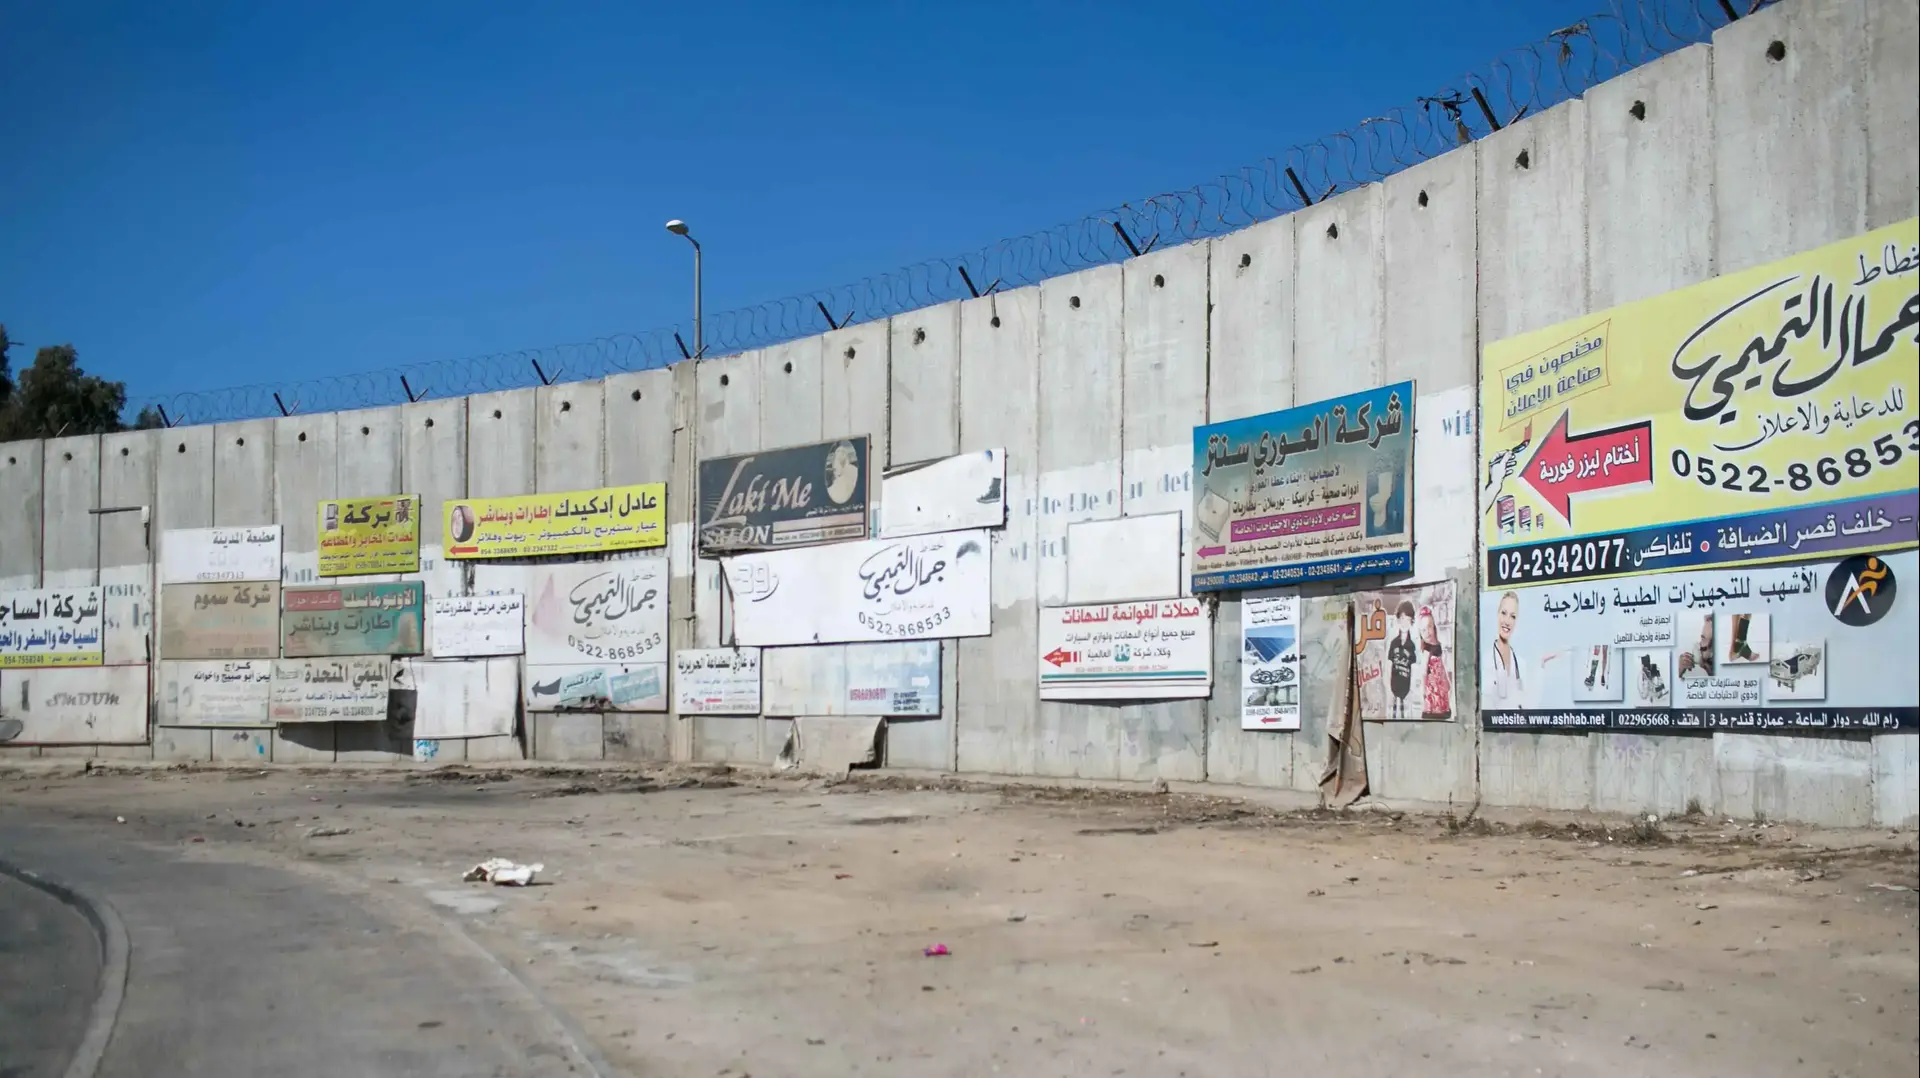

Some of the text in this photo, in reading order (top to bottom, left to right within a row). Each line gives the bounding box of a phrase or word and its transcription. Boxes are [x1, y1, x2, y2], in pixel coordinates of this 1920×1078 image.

[1672, 275, 1832, 425] التميمي
[1507, 336, 1602, 394] مختصون في
[1557, 366, 1602, 394] صناعة
[1333, 391, 1402, 449] شركة
[1834, 386, 1904, 429] للدعاية
[1202, 432, 1250, 476] سنتر
[1540, 435, 1640, 484] أختام ليزر فورية
[619, 491, 657, 517] عادل
[771, 476, 813, 512] Me
[343, 503, 391, 529] بركة
[515, 503, 551, 524] إطارات
[1841, 508, 1892, 535] خلف
[212, 529, 276, 549] مطبعة المدينة
[1718, 521, 1787, 554] الضيافة
[1789, 513, 1837, 551] قصر
[1499, 538, 1625, 581] 02-2342077
[859, 543, 947, 603] جمال التميمي
[233, 583, 272, 608] شركة
[569, 570, 658, 627] جمال التميمي
[1543, 566, 1818, 619] الأشهب للتجهيزات الطبية والعلاجية
[52, 591, 99, 625] شركة
[1061, 607, 1109, 624] للدهانات
[1161, 602, 1200, 619] محلات
[858, 605, 951, 637] 0522-868533
[23, 628, 57, 651] والسفر
[58, 626, 99, 650] للسياحة
[567, 631, 662, 660] 0522-868533
[1133, 646, 1152, 660] شركة
[1711, 678, 1741, 689] مستلزمات
[1743, 679, 1758, 689] جميع
[1740, 690, 1758, 703] وذوي
[1528, 711, 1605, 726] www.ashhab.net
[1618, 713, 1669, 726] 022965668
[1709, 713, 1716, 726] 3
[1718, 713, 1729, 726] ط
[1756, 713, 1785, 729] عمارة
[1795, 711, 1828, 726] الساعة
[1831, 713, 1850, 729] دوار
[1862, 712, 1880, 726] الله
[1882, 714, 1900, 729] رام
